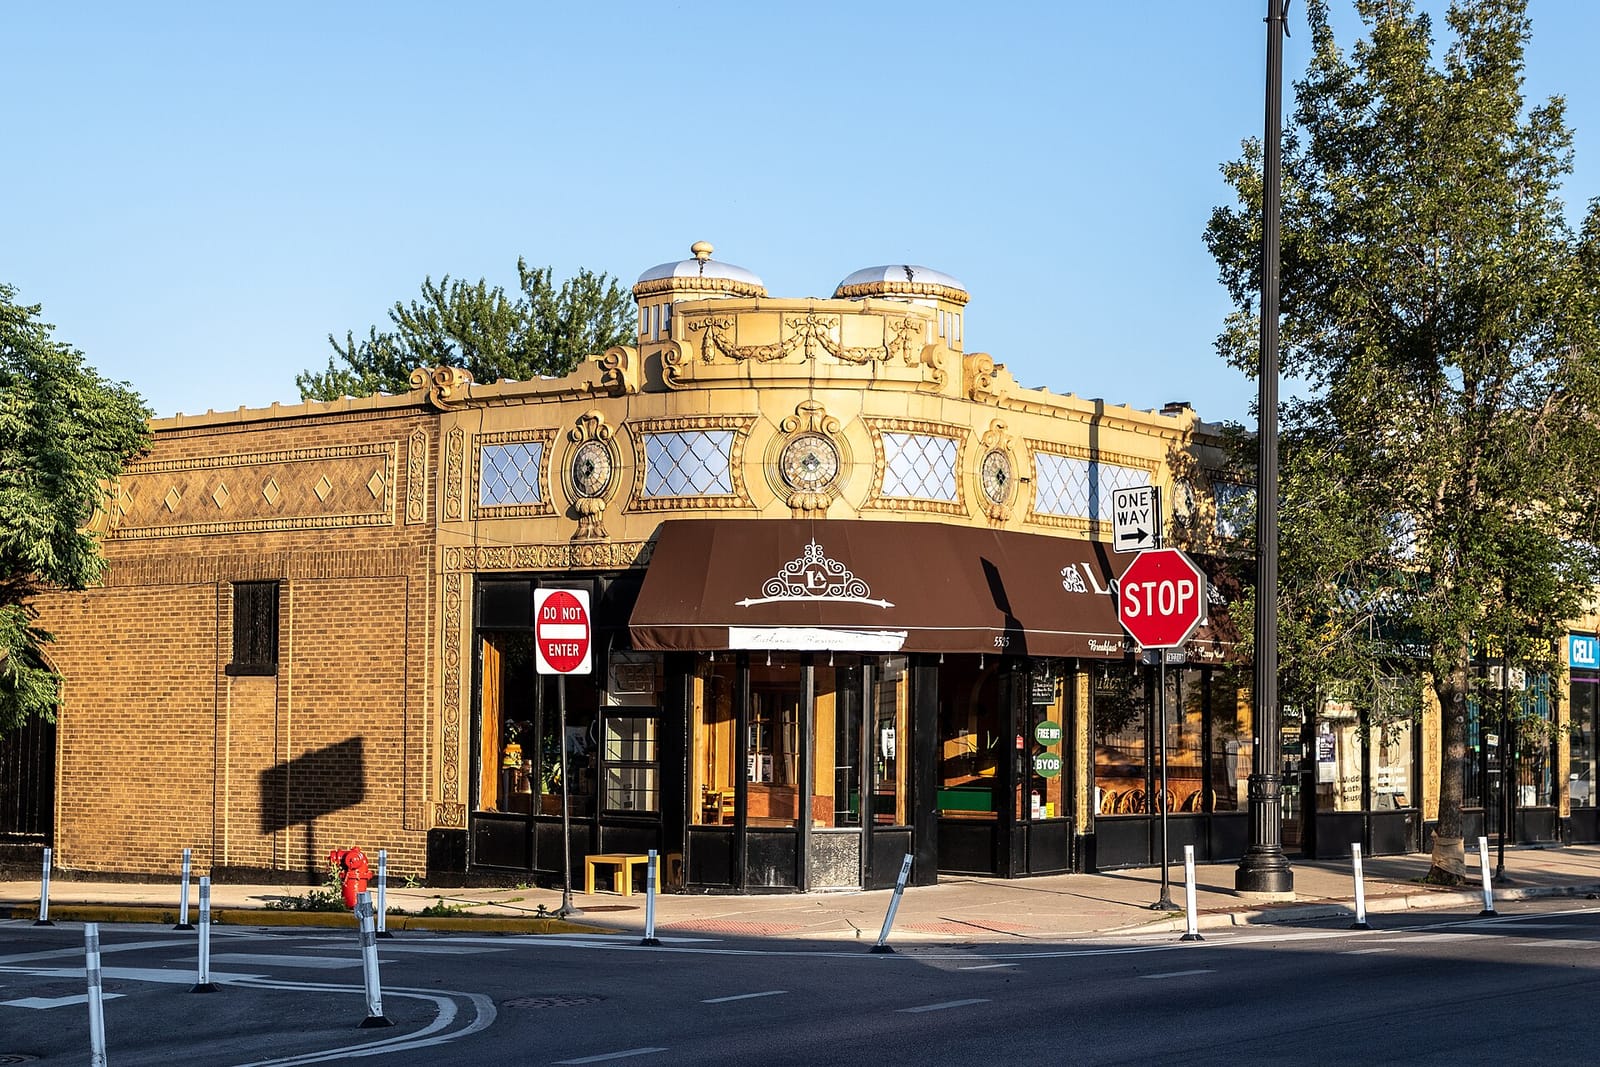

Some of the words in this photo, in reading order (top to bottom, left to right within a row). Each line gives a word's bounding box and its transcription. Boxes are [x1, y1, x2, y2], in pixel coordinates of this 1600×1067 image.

[1118, 491, 1148, 509] ONE
[1117, 508, 1149, 526] WAY
[1124, 579, 1194, 618] STOP
[543, 606, 557, 620] DO
[562, 607, 581, 620] NOT
[993, 636, 1010, 648] 5525
[1087, 639, 1118, 655] Breakfast
[548, 643, 579, 657] ENTER
[1573, 639, 1595, 664] CELL
[1037, 728, 1049, 739] FREE
[1036, 759, 1060, 770] BYOB
